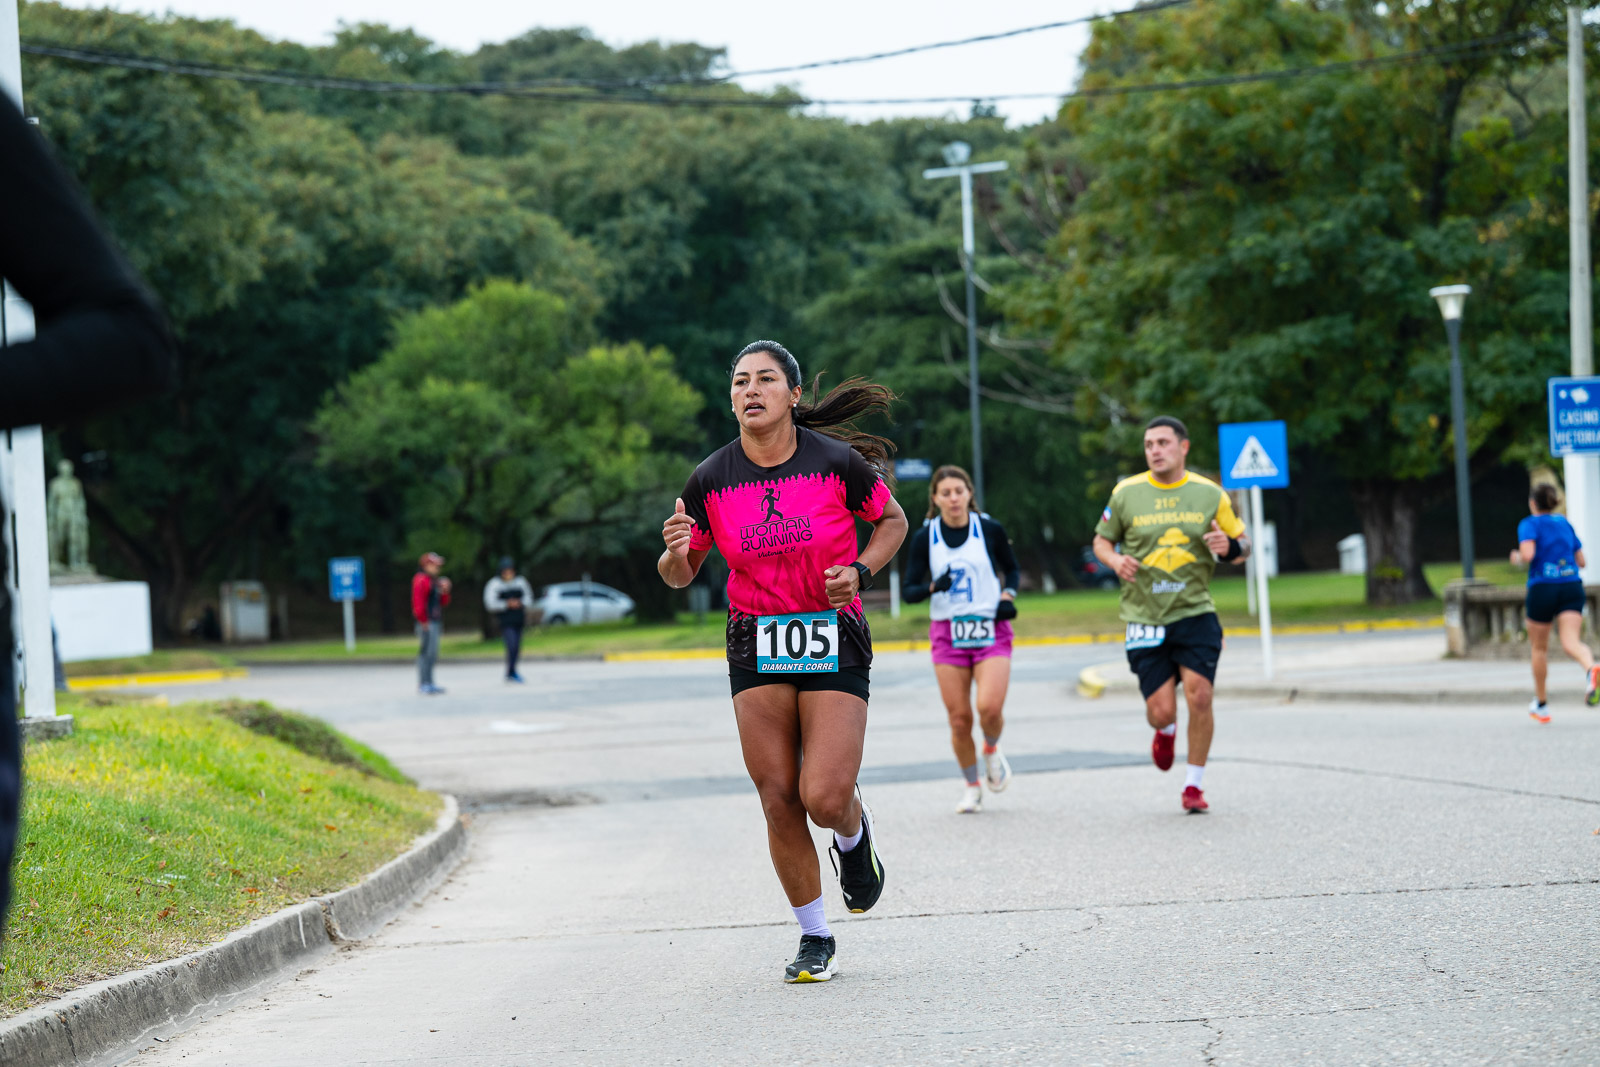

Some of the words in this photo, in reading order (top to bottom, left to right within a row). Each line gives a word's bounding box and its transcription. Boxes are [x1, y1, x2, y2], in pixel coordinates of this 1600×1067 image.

[1559, 408, 1599, 426] CASINO
[740, 516, 811, 540] WOMAN
[1132, 511, 1205, 528] ANIVERSARIO
[741, 529, 813, 553] RUNNING
[763, 618, 831, 661] 105
[954, 617, 990, 641] 025
[761, 662, 805, 672] DIAMANTE
[805, 662, 834, 671] CORRE
